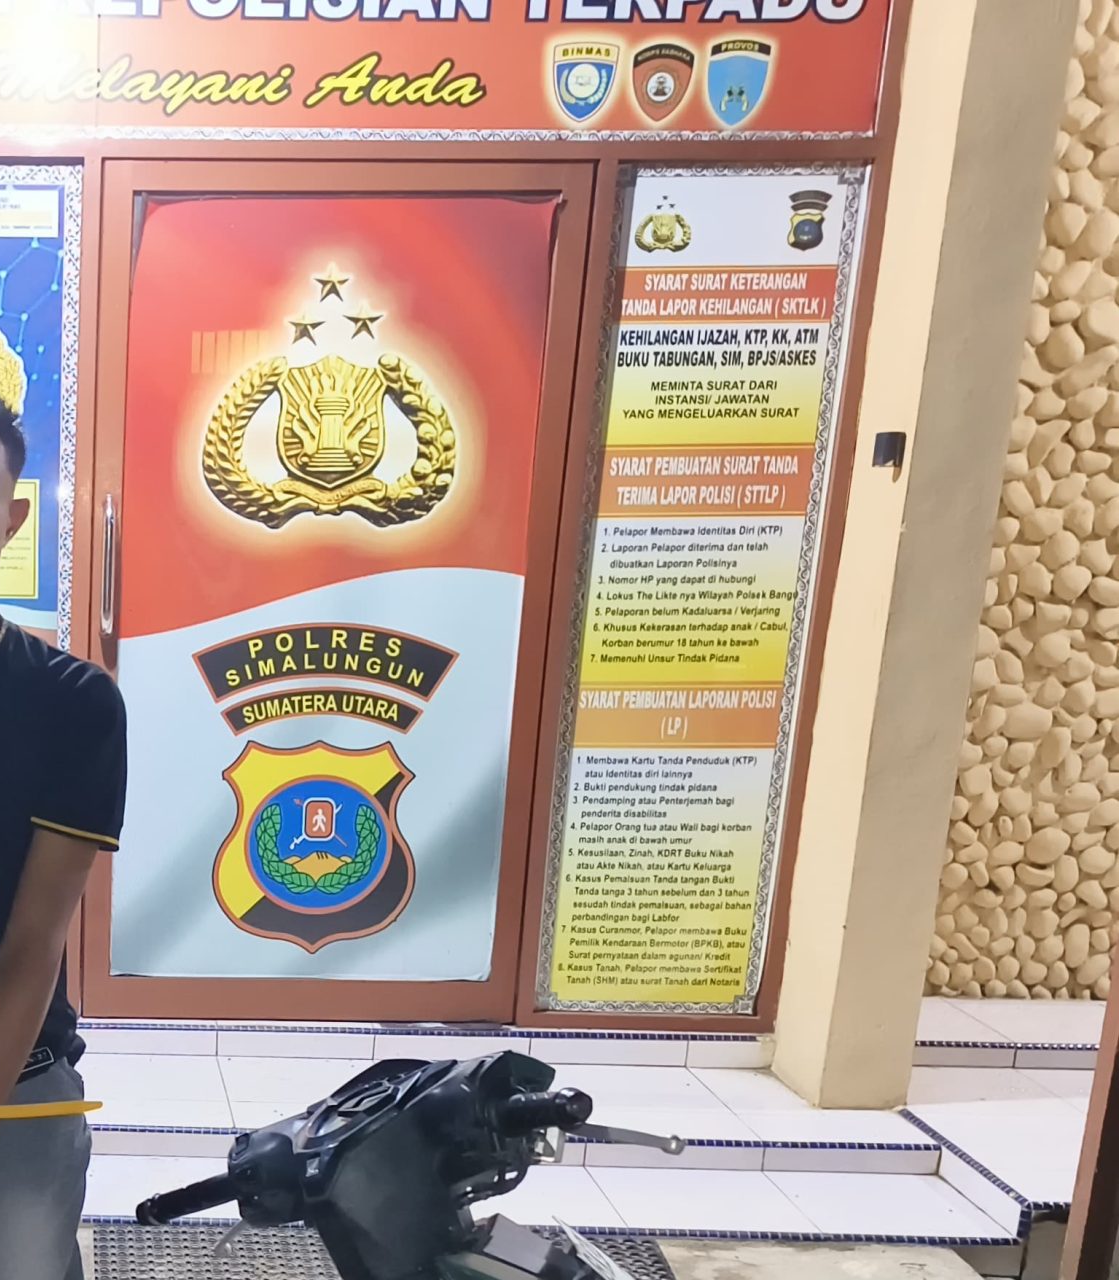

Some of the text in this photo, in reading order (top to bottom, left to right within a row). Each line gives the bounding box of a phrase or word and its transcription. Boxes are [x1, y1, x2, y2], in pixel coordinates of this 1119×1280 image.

[562, 48, 611, 56] BINMAS
[721, 42, 759, 51] PROVOS
[303, 52, 485, 108] Anda
[645, 273, 807, 291] SYARAT SURAT KETERANGAN
[621, 300, 656, 316] TANDA
[660, 300, 696, 315] LAPOR
[700, 299, 772, 315] KEHILANGAN
[782, 298, 819, 314] SKTLK
[620, 329, 819, 348] KEHILANGAN IJAZAH, KTP, KK, ATM
[617, 350, 816, 369] BUKU TABUNGAN, SIM, BPJS/ASKES
[651, 381, 777, 391] MEMINTA SURAT DARI
[655, 395, 769, 405] INSTANSI/ JAWATAN
[623, 408, 799, 419] YANG MENGELUARKAN SURAT
[610, 456, 798, 476] SYARAT PEMBUATAN SURAT TANDA
[617, 487, 658, 505] TERIMA
[661, 486, 696, 505] LAPOR
[699, 486, 735, 504] POLISI
[744, 485, 779, 504] STTLP
[614, 528, 647, 538] Pelapor
[650, 528, 695, 536] Membawa
[739, 526, 755, 535] Diri
[757, 526, 783, 537] (KTP)
[612, 543, 648, 554] Laporan
[651, 543, 685, 554] Pelapor
[688, 542, 724, 551] diterima
[727, 542, 743, 551] dan
[747, 542, 768, 551] telah
[610, 559, 737, 570] dibuatkan Laporan Polisinya
[608, 576, 637, 584] Nomor
[641, 575, 653, 583] HP
[656, 577, 677, 586] yang
[681, 575, 705, 585] dapat
[708, 574, 716, 583] di
[719, 574, 755, 585] hubungi
[605, 608, 649, 618] Pelaporan
[652, 607, 679, 616] belum
[682, 607, 732, 615] Kadaluarsa
[740, 606, 780, 617] Verjaring
[248, 630, 402, 658] POLRES
[602, 639, 633, 647] Korban
[636, 639, 673, 647] berumur
[677, 639, 686, 647] 18
[689, 639, 714, 647] tahun
[730, 638, 758, 646] bawah
[601, 654, 645, 663] Memenuhi
[648, 654, 674, 662] Unsur
[678, 654, 706, 662] Tindak
[710, 654, 739, 662] Pidana
[225, 652, 424, 687] SIMALUNGUN
[580, 690, 775, 709] SYARAT PEMBUATAN LAPORAN POLISI
[242, 694, 399, 724] SUMATERA UTARA
[667, 717, 681, 736] LP
[586, 756, 757, 766] Membawa Kartu Tanda Penduduk (KTP)
[584, 783, 605, 791] Bukti
[608, 783, 656, 793] pendukung
[659, 783, 685, 792] tindak
[688, 783, 717, 792] pidana
[581, 810, 667, 819] penderita disabilitas
[572, 914, 679, 923] perbandingan bagi Labfor
[567, 976, 590, 984] Tanah
[593, 976, 618, 985] (SHM)
[665, 977, 688, 985] Tanah
[691, 977, 707, 985] dari
[710, 978, 740, 986] Notaris
